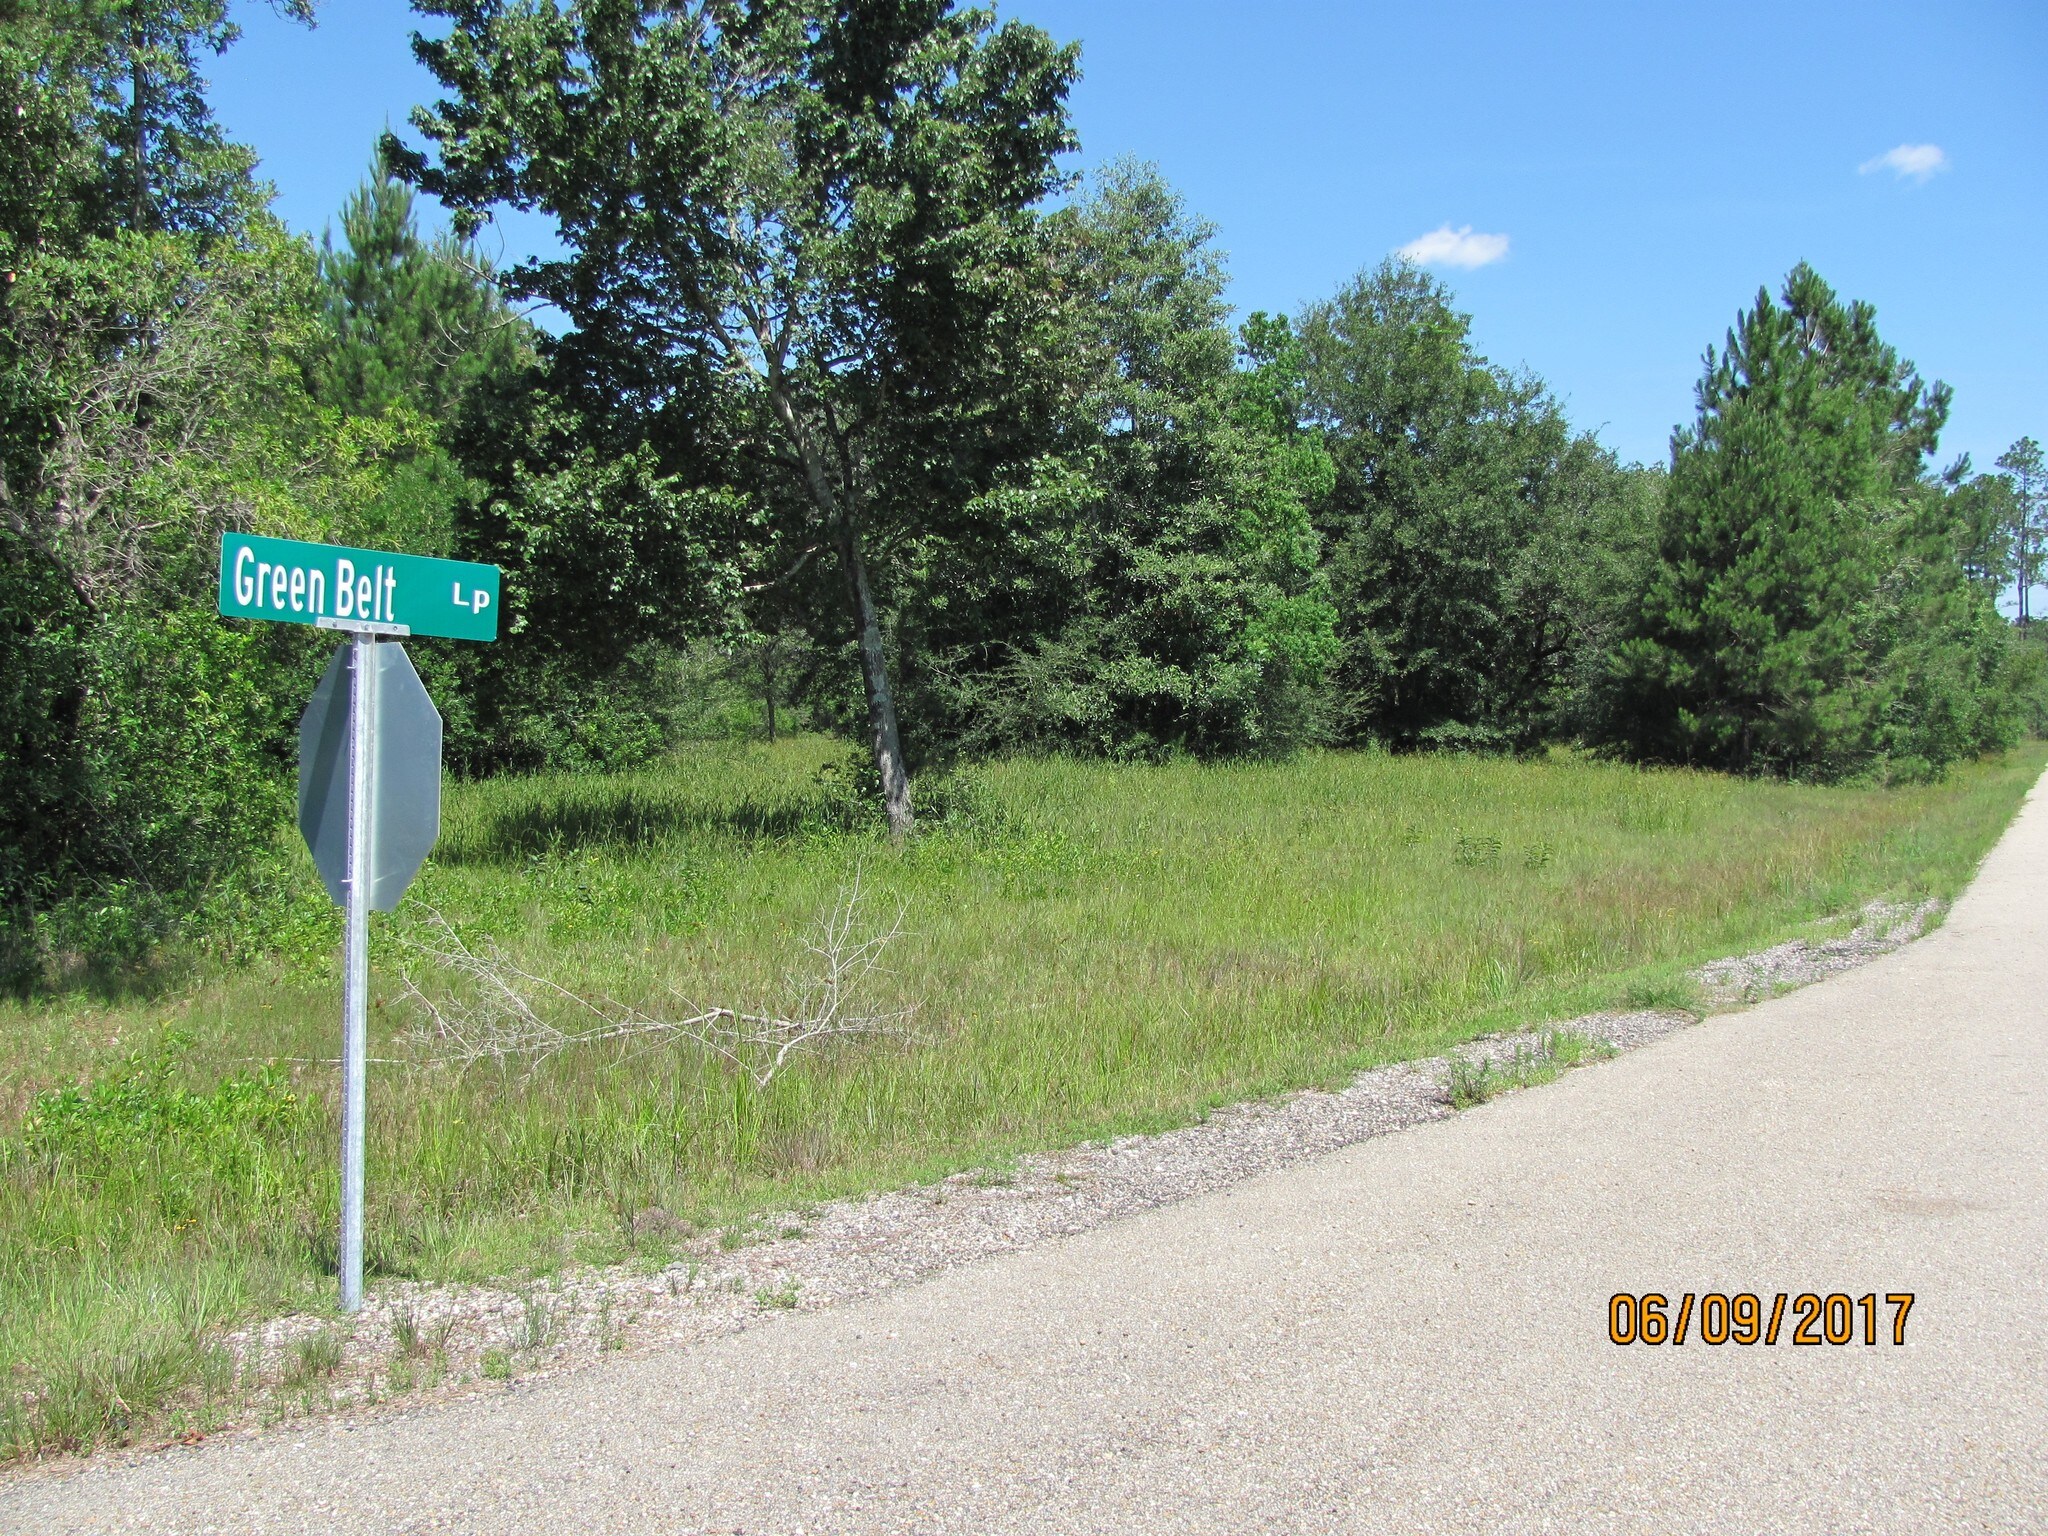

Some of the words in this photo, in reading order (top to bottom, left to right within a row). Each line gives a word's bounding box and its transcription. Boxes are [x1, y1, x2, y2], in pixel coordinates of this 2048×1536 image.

[234, 545, 326, 615] Green
[334, 558, 397, 623] Belt
[452, 581, 491, 615] Lp
